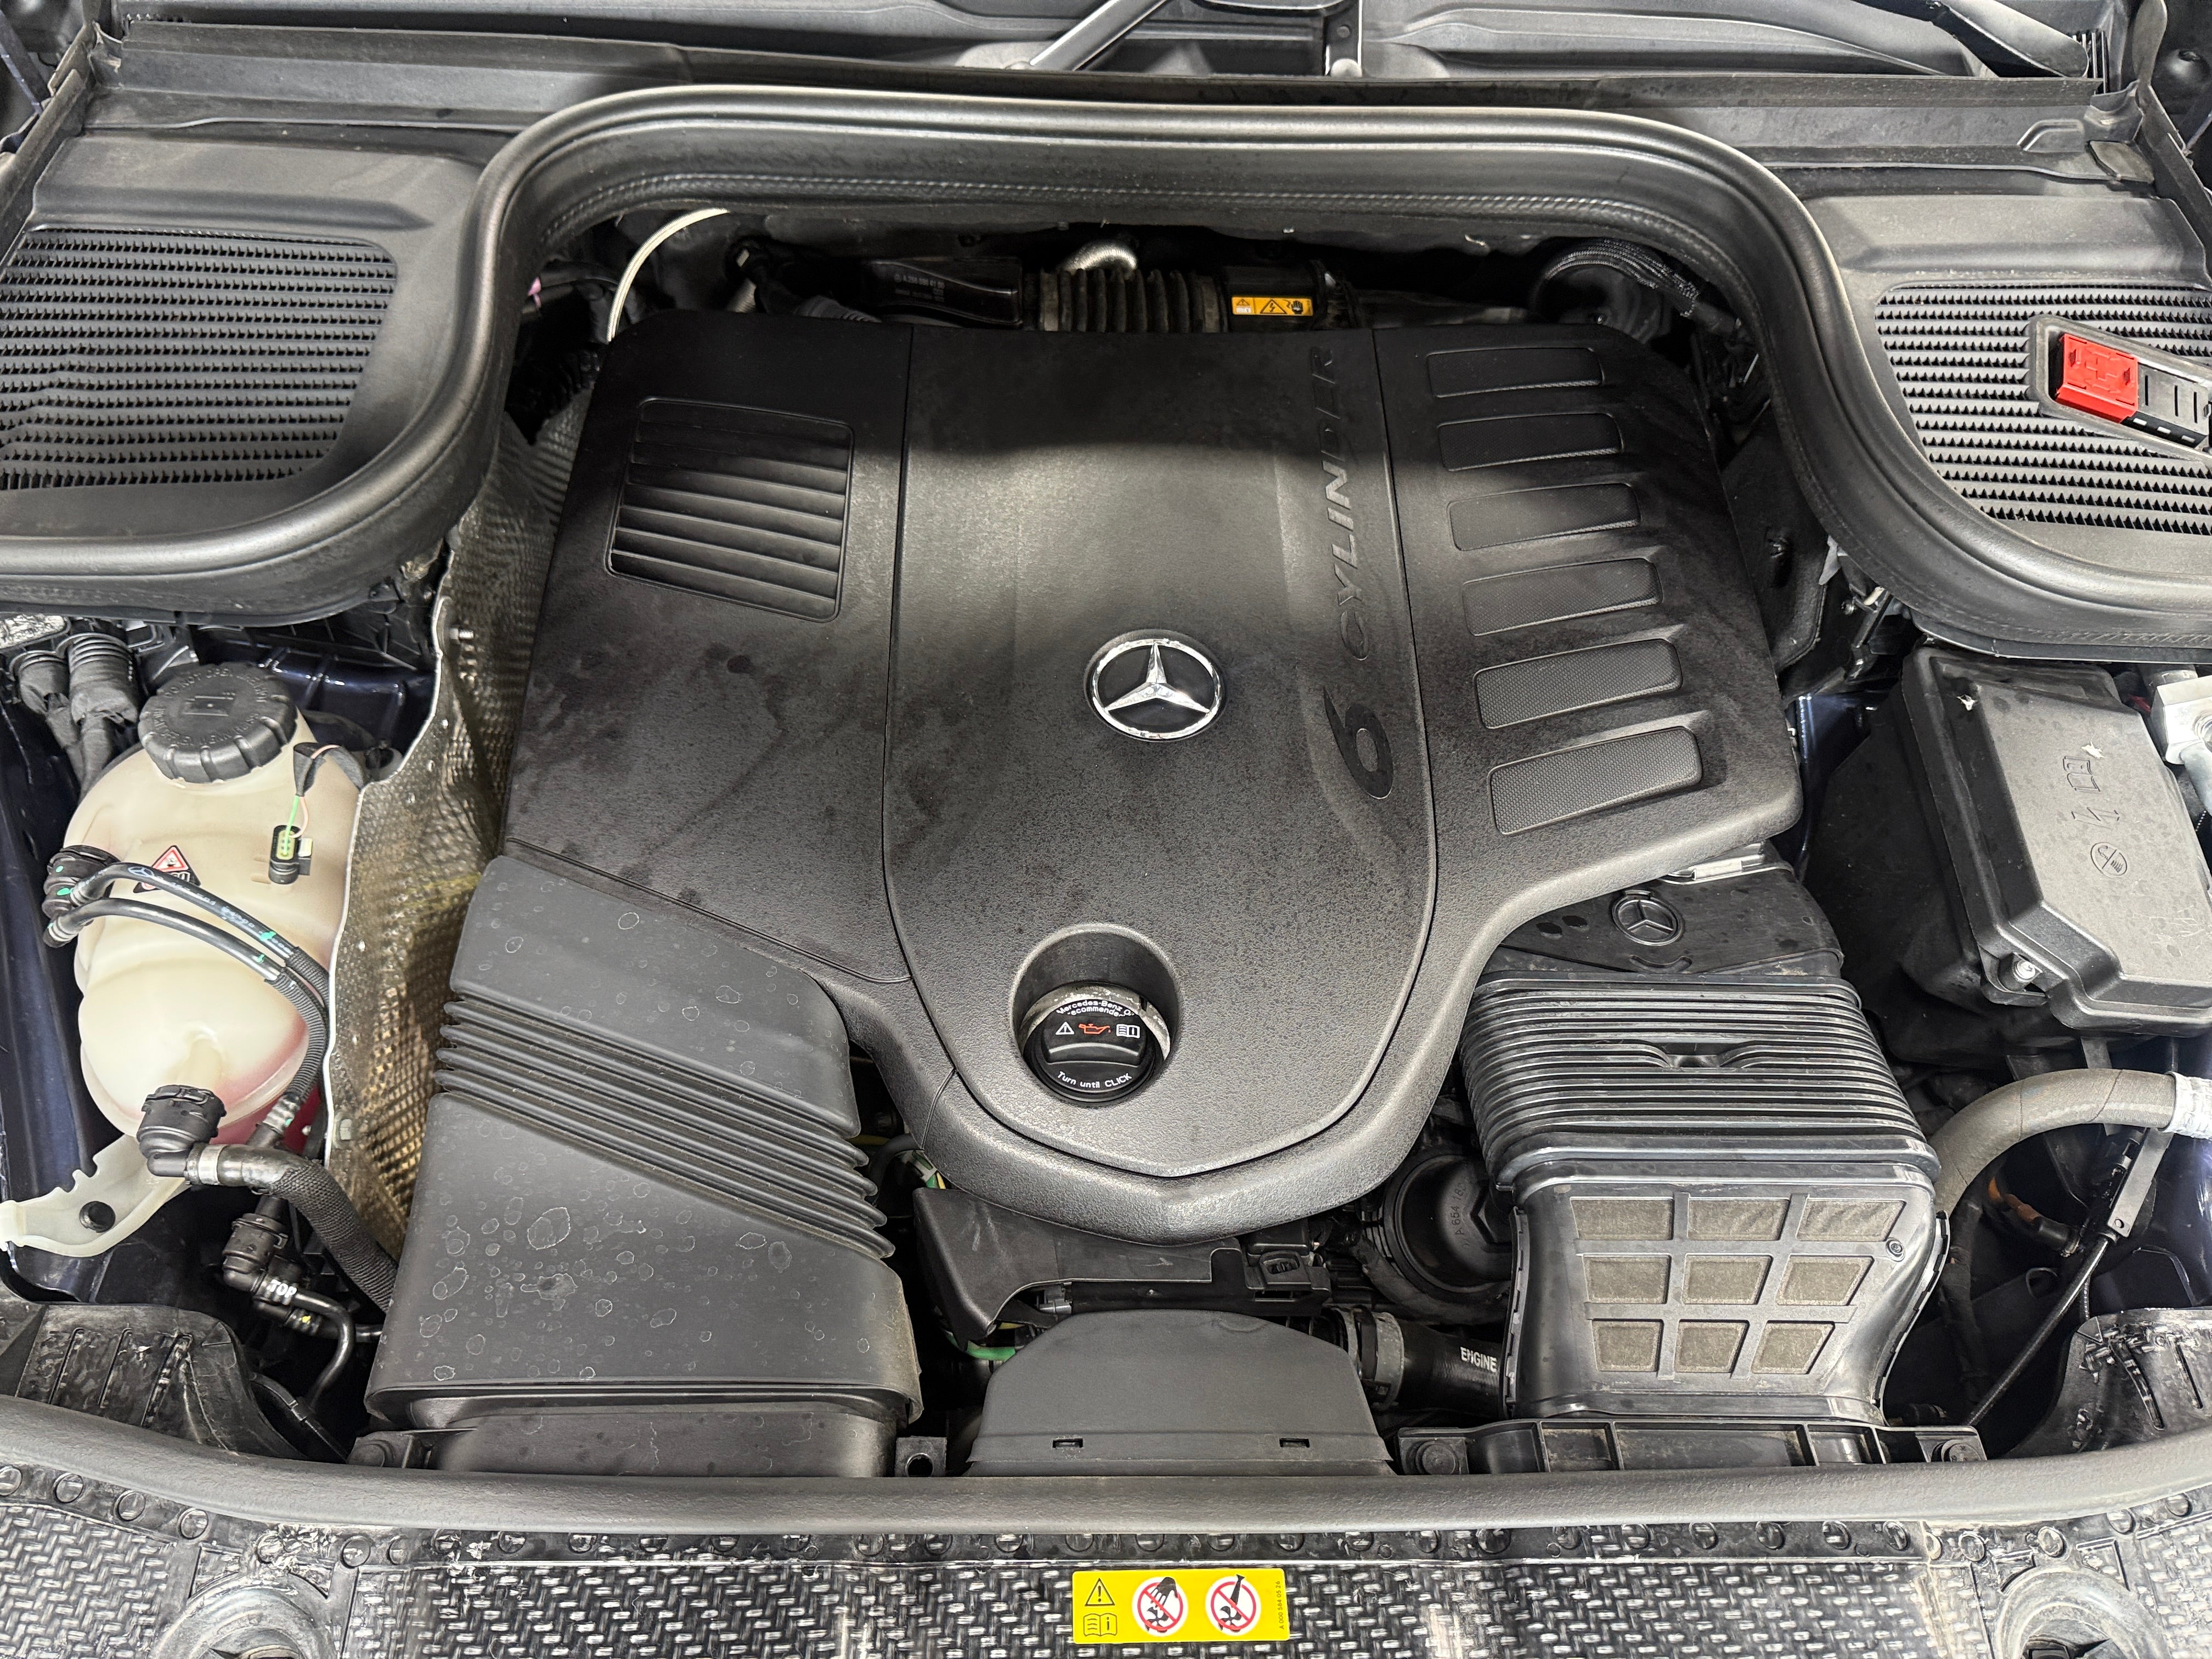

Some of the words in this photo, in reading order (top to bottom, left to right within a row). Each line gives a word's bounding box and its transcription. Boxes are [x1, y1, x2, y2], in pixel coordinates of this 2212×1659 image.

[1310, 346, 1370, 661] CYLINDER
[1323, 686, 1394, 800] 6
[1056, 1000, 1123, 1014] Mercedes-Benz
[1057, 1071, 1077, 1086] Turn
[1080, 1080, 1101, 1088] until
[1104, 1073, 1132, 1087] CLICK
[1451, 1205, 1460, 1225] 654
[269, 1279, 297, 1298] TOP
[1460, 1346, 1498, 1372] ENGINE
[1276, 1581, 1281, 1589] 26
